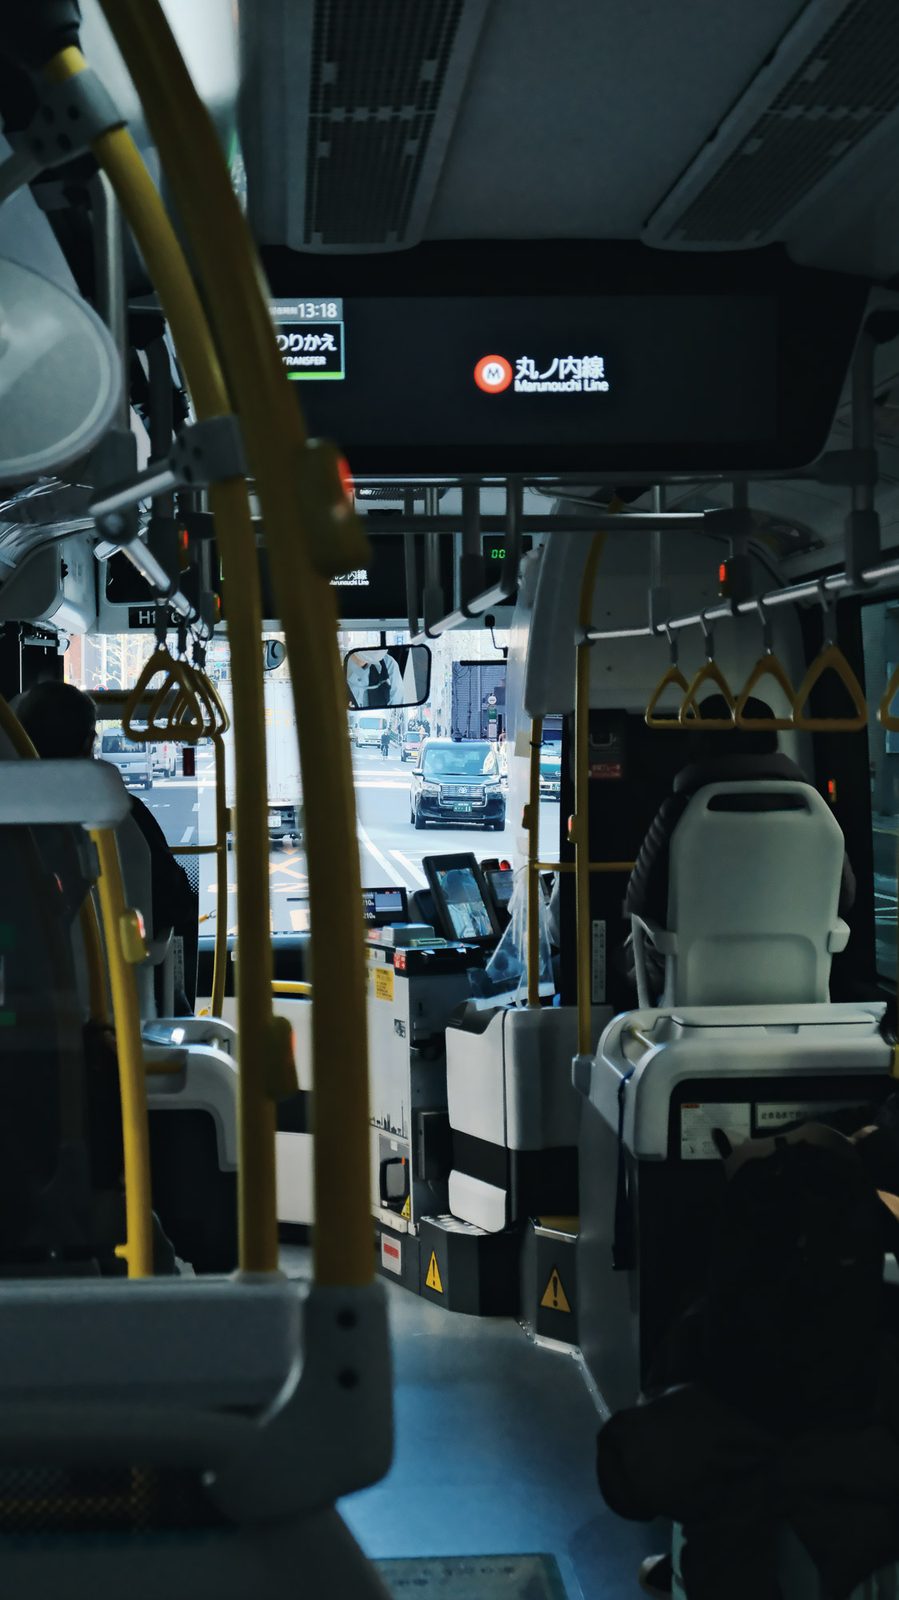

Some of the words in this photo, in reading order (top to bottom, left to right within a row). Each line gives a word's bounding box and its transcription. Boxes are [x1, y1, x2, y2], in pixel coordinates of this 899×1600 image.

[298, 302, 338, 318] 13:18
[275, 333, 338, 352] のりかえ
[515, 355, 605, 380] 丸ノ内線
[514, 379, 582, 393] Marunouchi
[583, 379, 610, 392] Line
